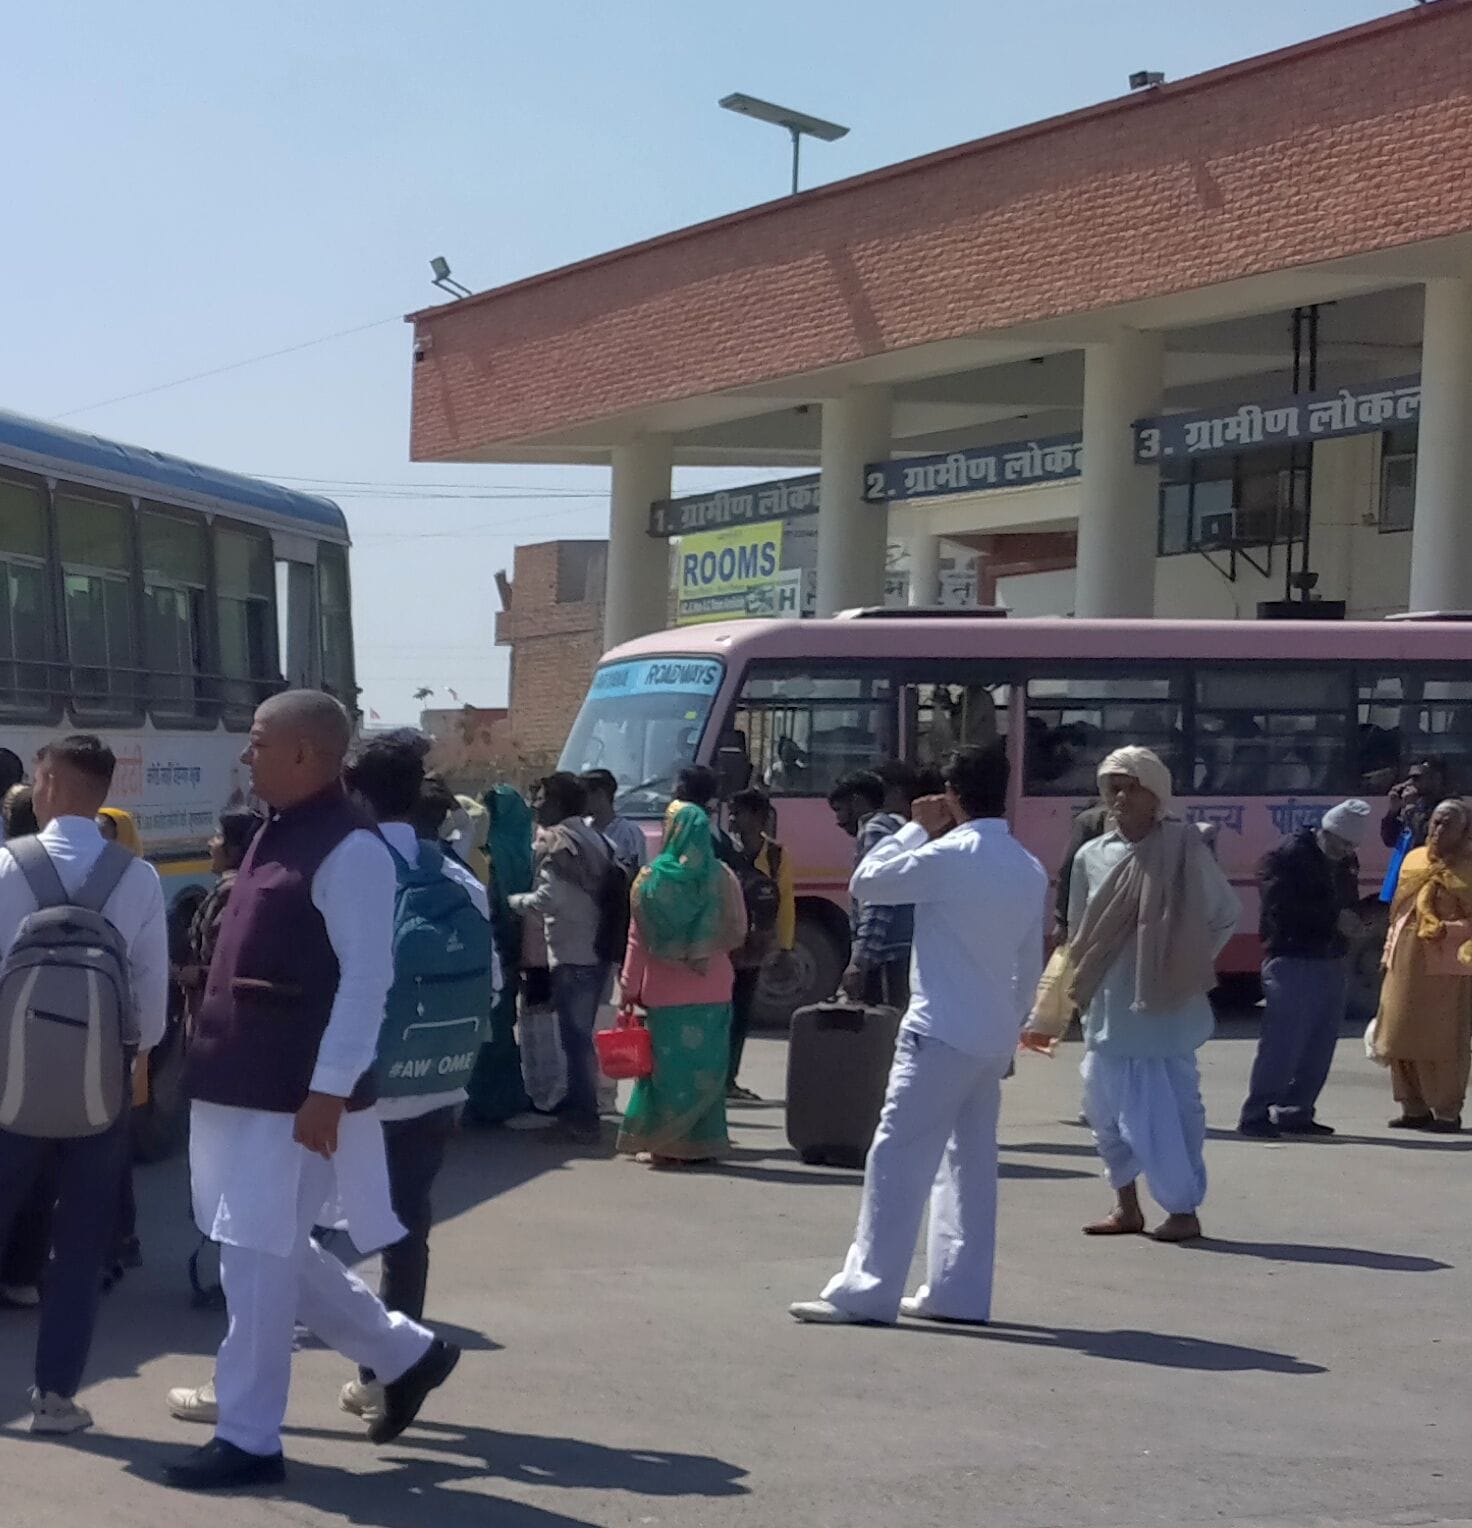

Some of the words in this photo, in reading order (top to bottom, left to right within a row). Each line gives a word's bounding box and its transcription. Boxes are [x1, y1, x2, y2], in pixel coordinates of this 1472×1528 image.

[1139, 428, 1173, 459] 3.
[1184, 405, 1300, 453] ग्रामीण
[866, 472, 896, 499] 2.
[903, 453, 997, 494] ग्रामीण
[1002, 442, 1082, 481] लोक
[681, 491, 754, 528] ग्रामीण
[758, 482, 820, 516] लोक
[683, 541, 776, 587] ROOMS
[644, 663, 718, 686] ROADWAYS
